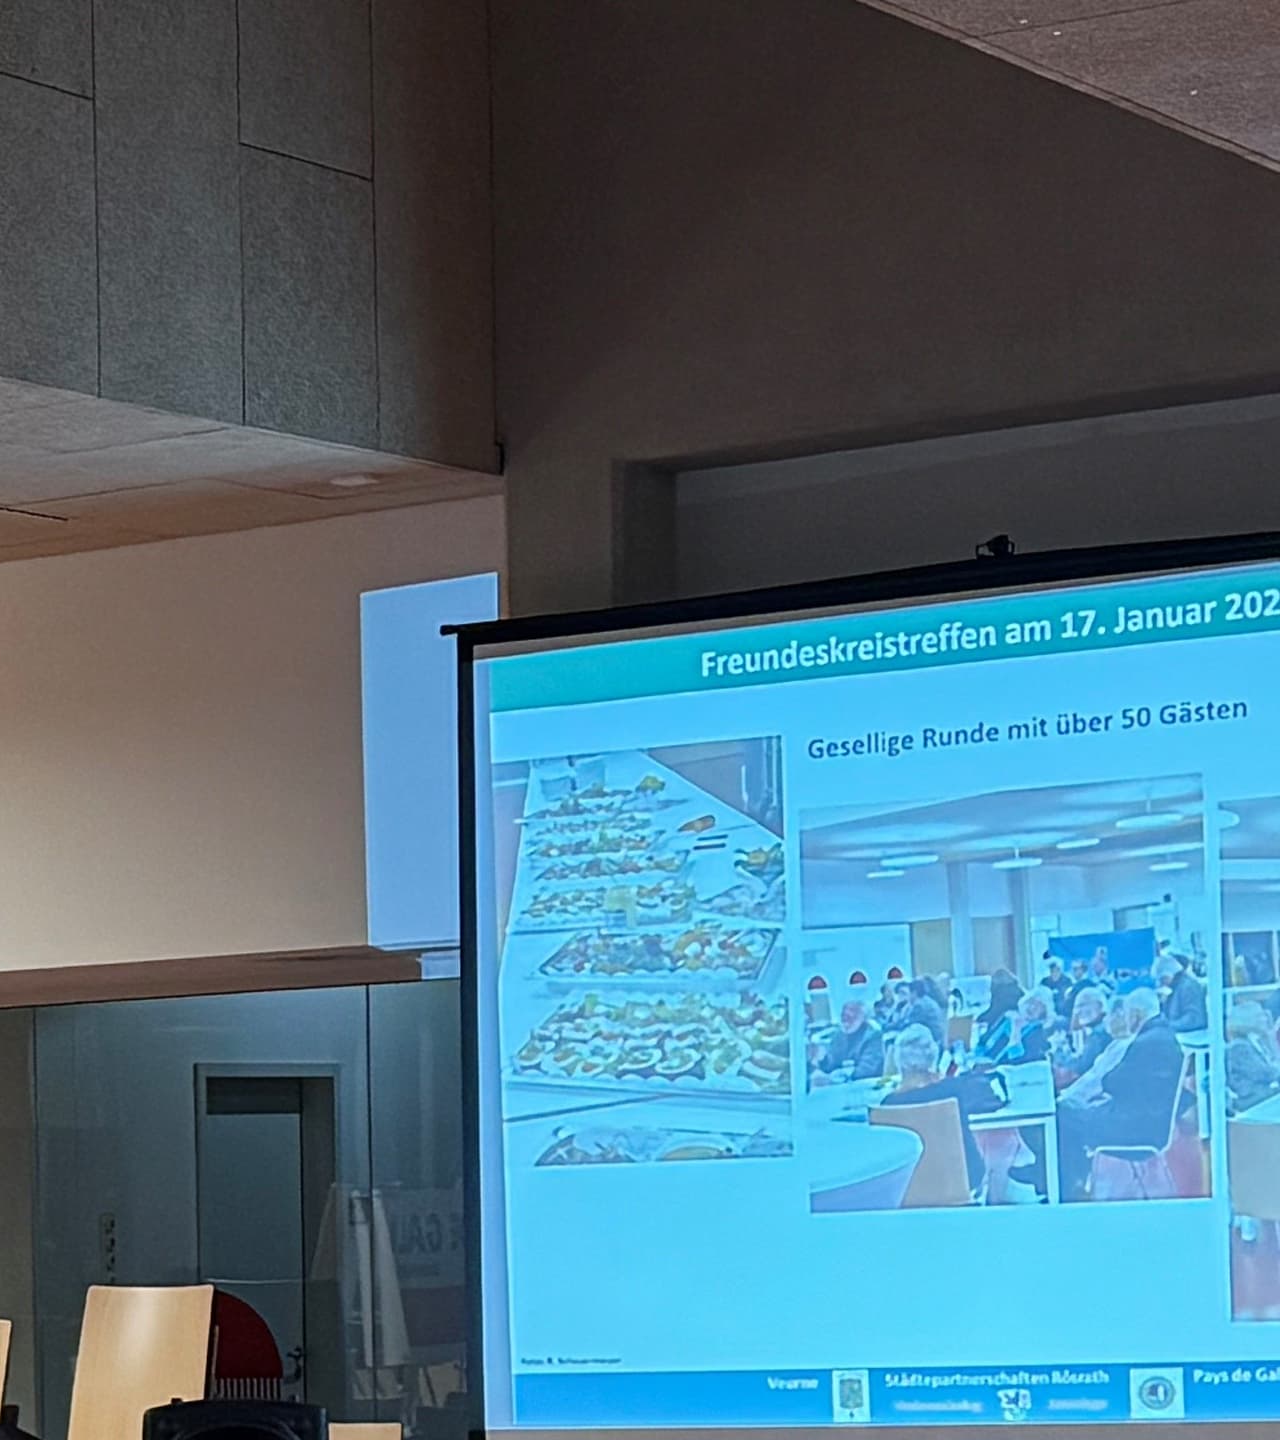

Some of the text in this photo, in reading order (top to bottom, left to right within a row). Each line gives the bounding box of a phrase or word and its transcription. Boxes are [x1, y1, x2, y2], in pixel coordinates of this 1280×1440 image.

[701, 587, 1280, 677] Freundeskreistreffen am 17. Januar 202
[807, 700, 1248, 760] Gesellige Runde mit über 50 Gästen
[1192, 1368, 1229, 1385] Pays
[1231, 1367, 1253, 1383] de
